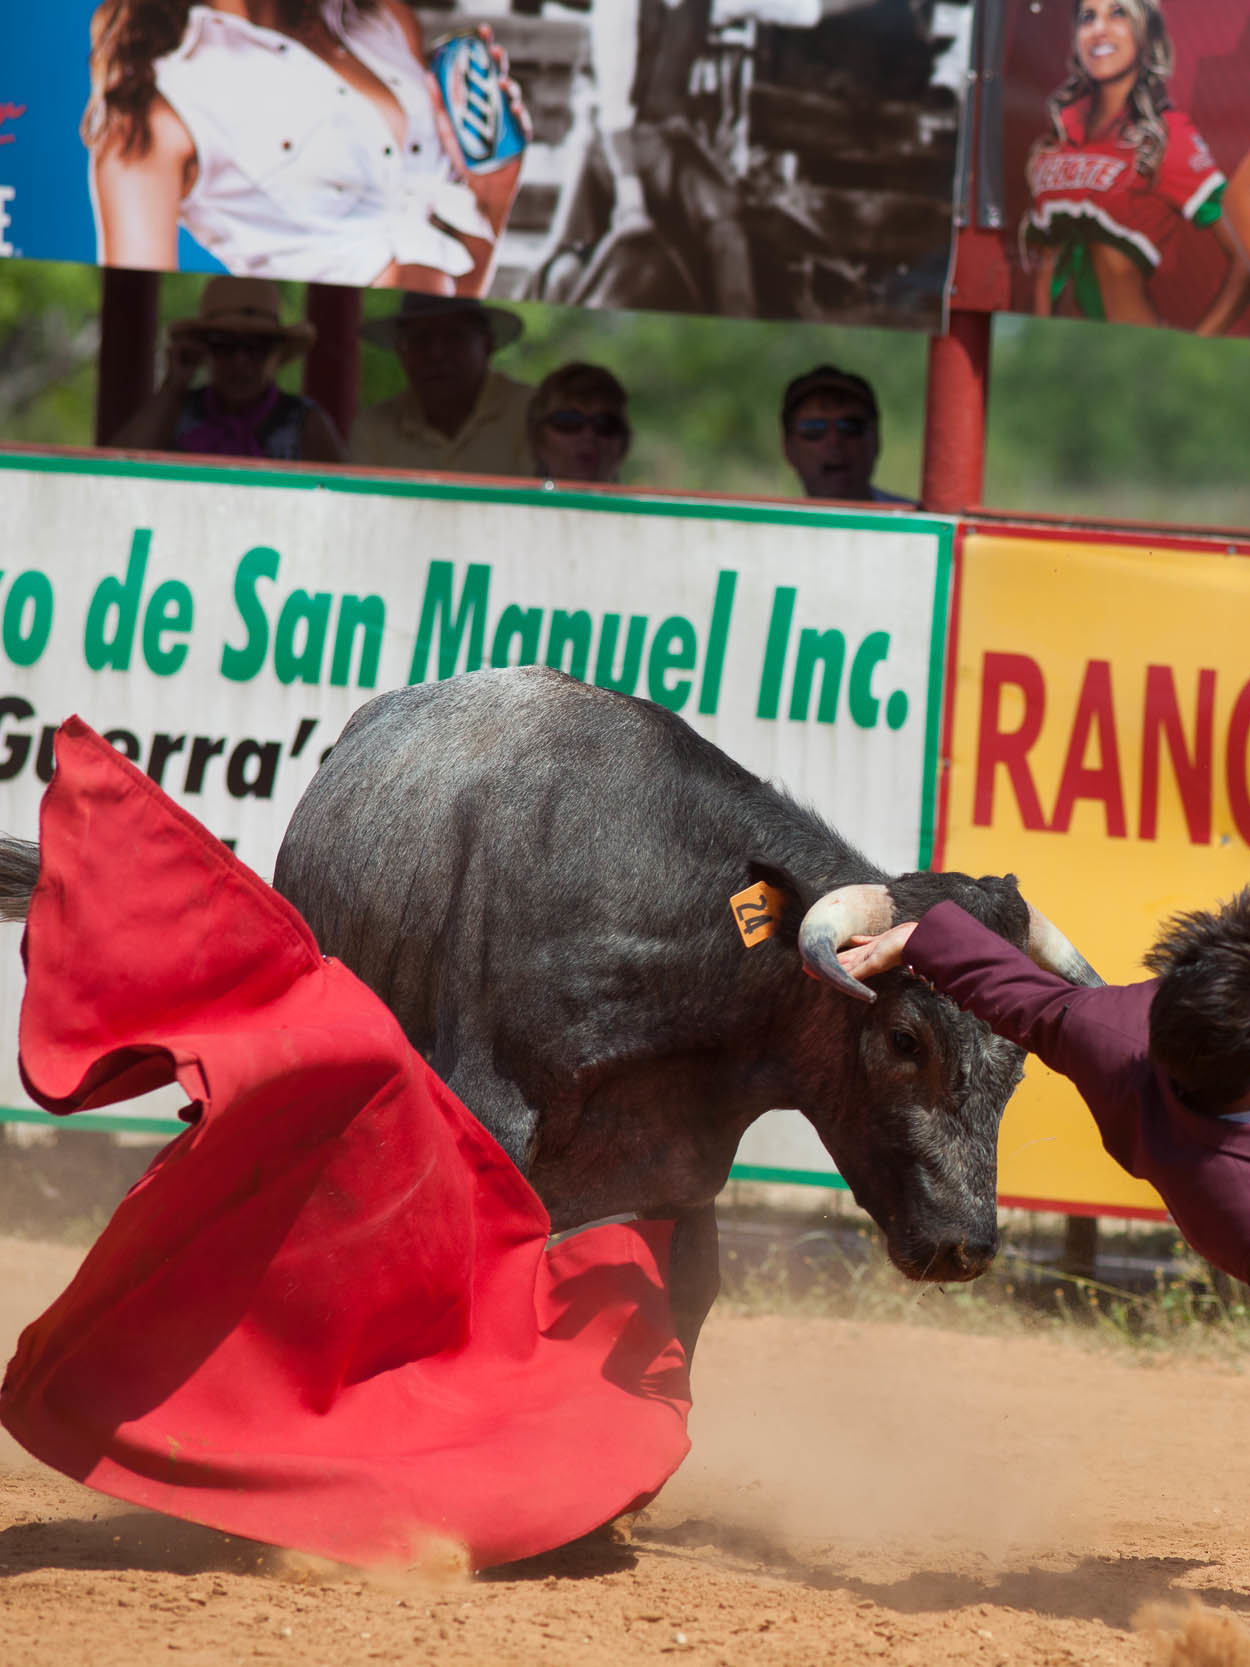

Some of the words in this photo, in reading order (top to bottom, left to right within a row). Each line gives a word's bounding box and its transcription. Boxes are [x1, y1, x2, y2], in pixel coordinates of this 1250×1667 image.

[0, 570, 53, 667] o
[84, 528, 194, 677] de
[220, 546, 387, 689] San
[408, 560, 738, 716] Manuel
[757, 586, 909, 731] Inc.
[736, 894, 773, 935] 24
